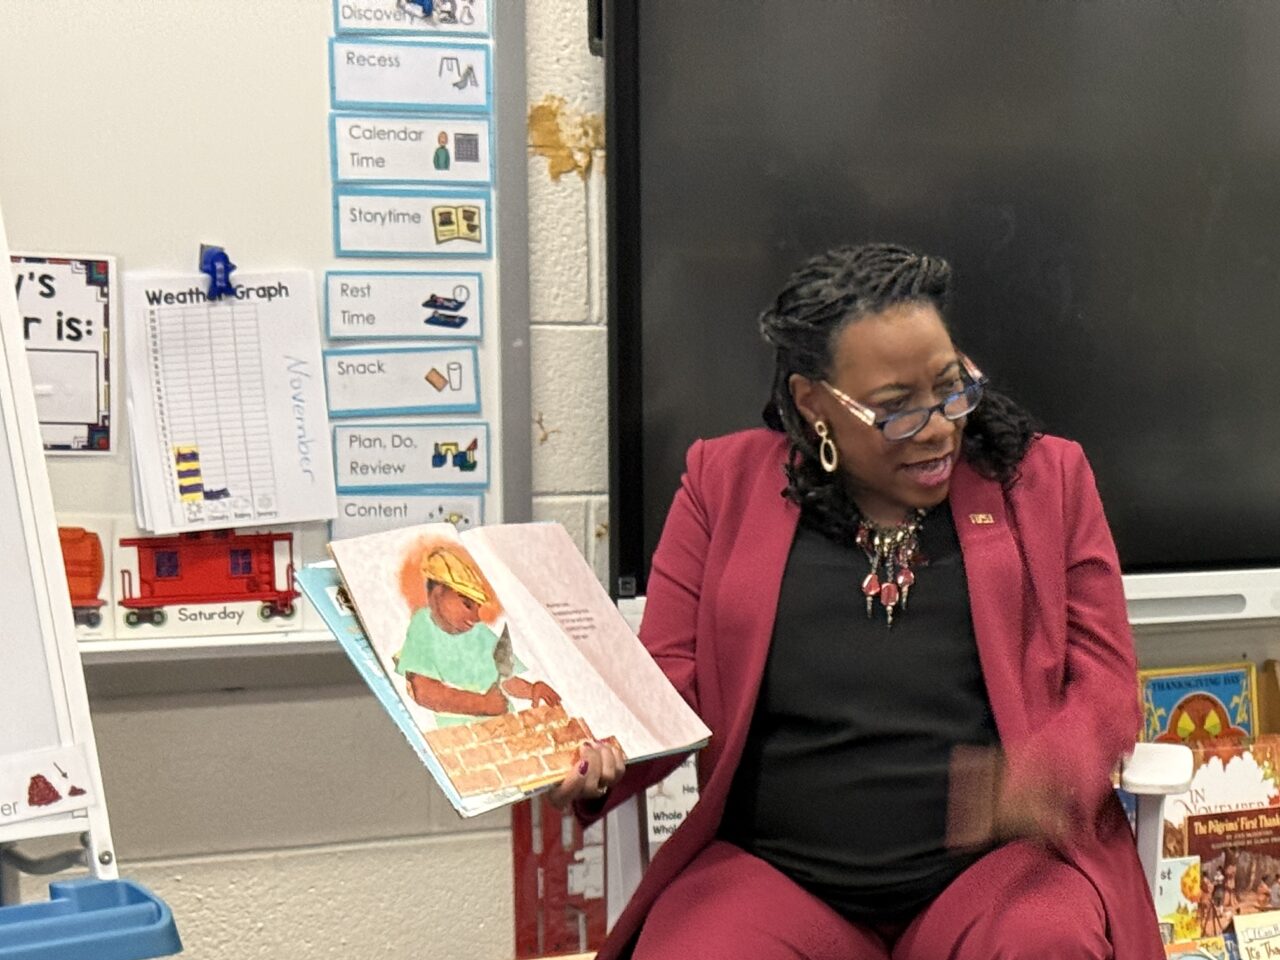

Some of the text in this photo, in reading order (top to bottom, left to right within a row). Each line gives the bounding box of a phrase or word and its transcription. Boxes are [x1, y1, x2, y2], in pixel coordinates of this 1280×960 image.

[346, 51, 400, 68] Recess
[349, 125, 423, 142] Calendar
[350, 153, 386, 168] Time
[350, 207, 421, 226] Storytime
[145, 281, 289, 306] Weath Graph
[340, 283, 371, 298] Rest
[341, 310, 375, 325] Time
[56, 310, 93, 342] is:
[337, 361, 386, 376] Snack
[283, 354, 316, 483] November
[350, 461, 406, 475] Review
[344, 503, 408, 517] Content
[178, 607, 244, 626] Saturday
[1151, 675, 1242, 691] THANKSGIVING DAY
[1189, 788, 1205, 804] IN
[653, 811, 682, 821] Whole
[1194, 821, 1208, 835] The
[1208, 817, 1239, 836] Pilgrims'
[1240, 815, 1258, 832] First
